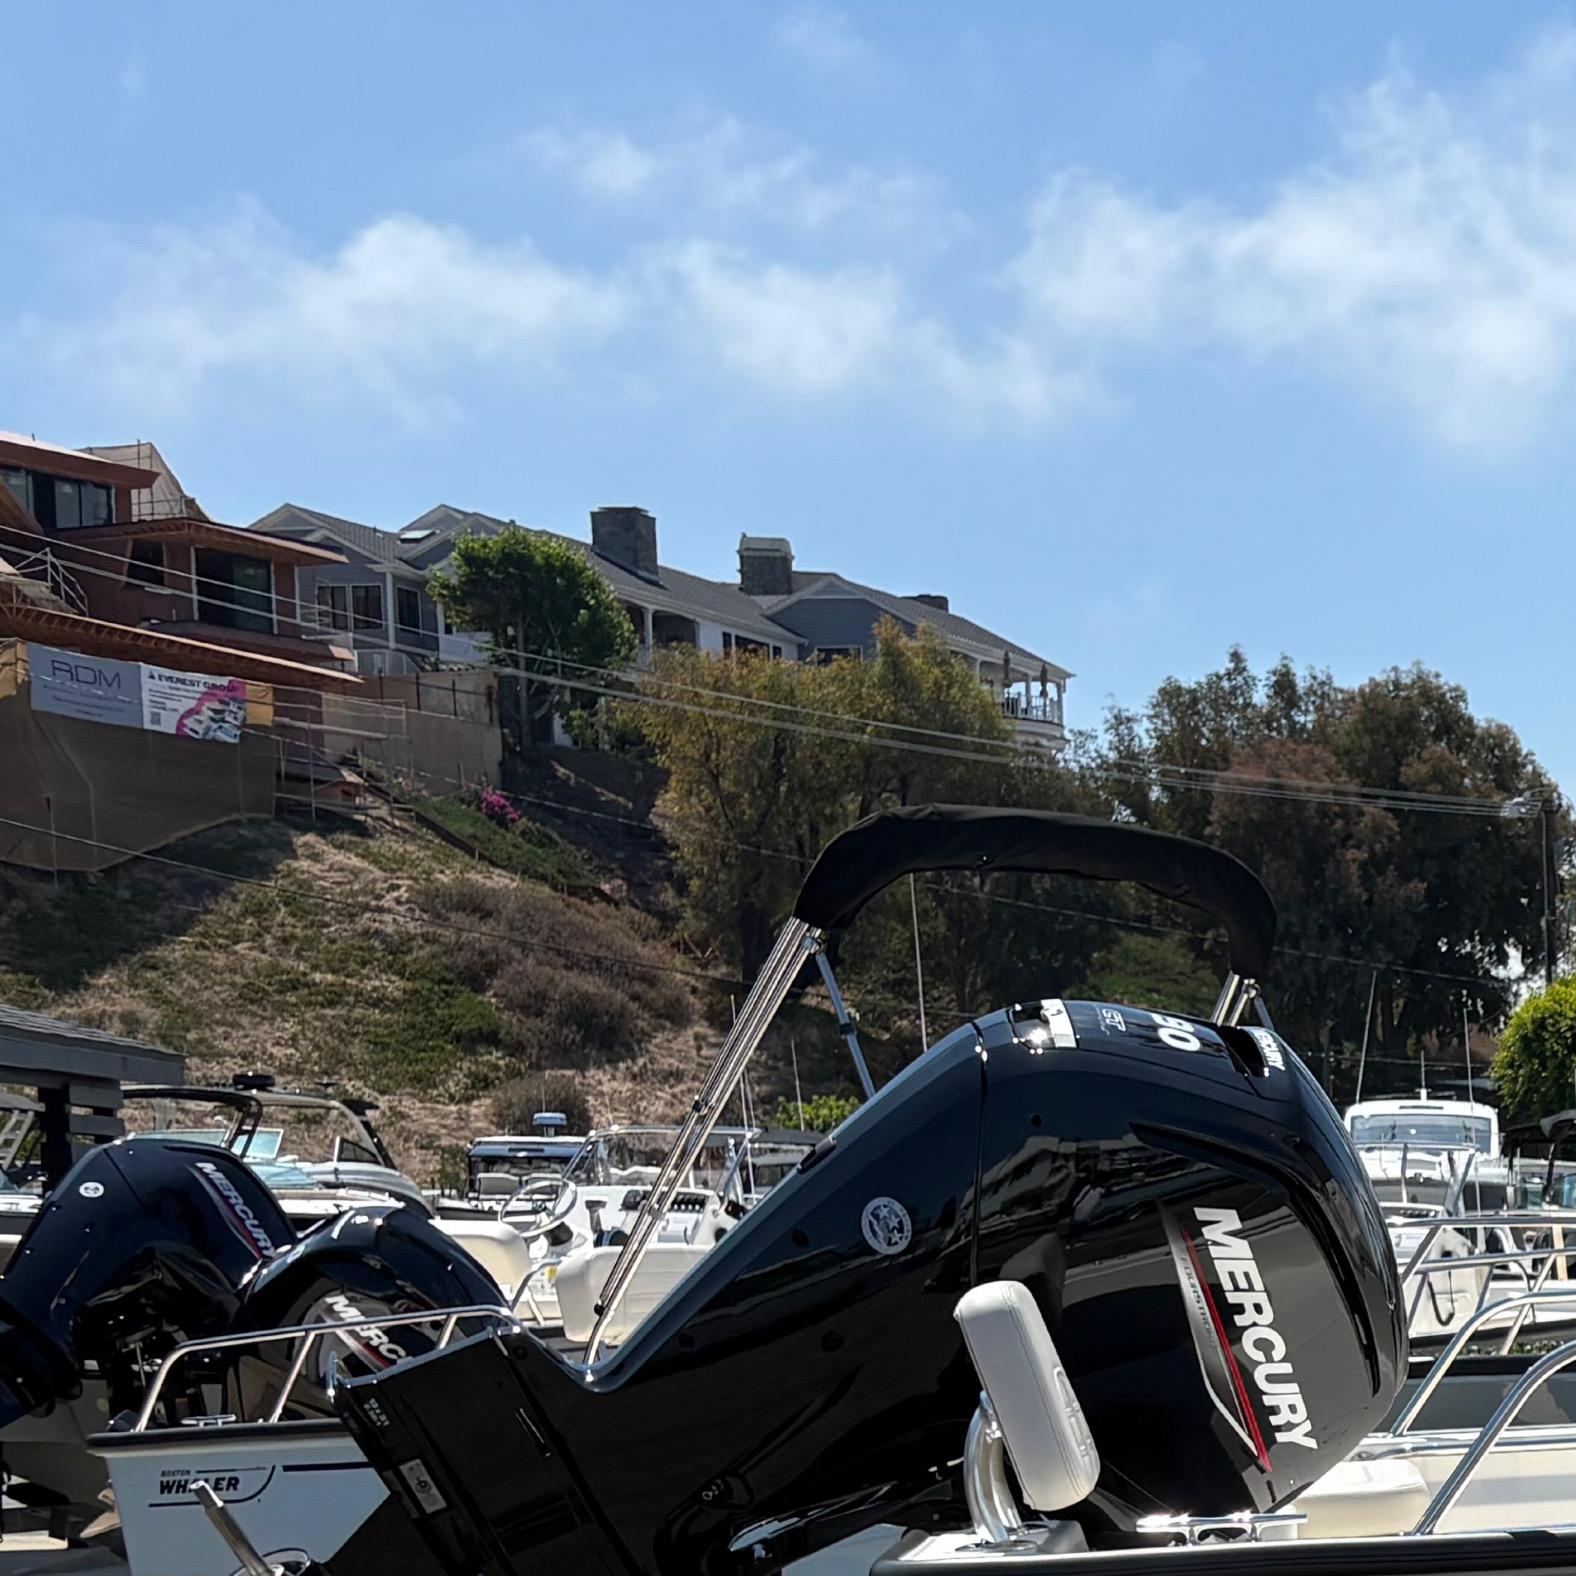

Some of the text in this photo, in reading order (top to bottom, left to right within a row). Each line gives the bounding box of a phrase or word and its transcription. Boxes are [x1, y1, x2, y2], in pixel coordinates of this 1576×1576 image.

[50, 659, 121, 690] RDM
[158, 673, 201, 688] EVEREST
[1151, 1013, 1202, 1052] 90
[196, 1162, 275, 1258] MERCURY
[324, 1295, 407, 1360] MERC
[1192, 1206, 1319, 1450] MERCURY
[160, 1469, 191, 1478] BOSTON
